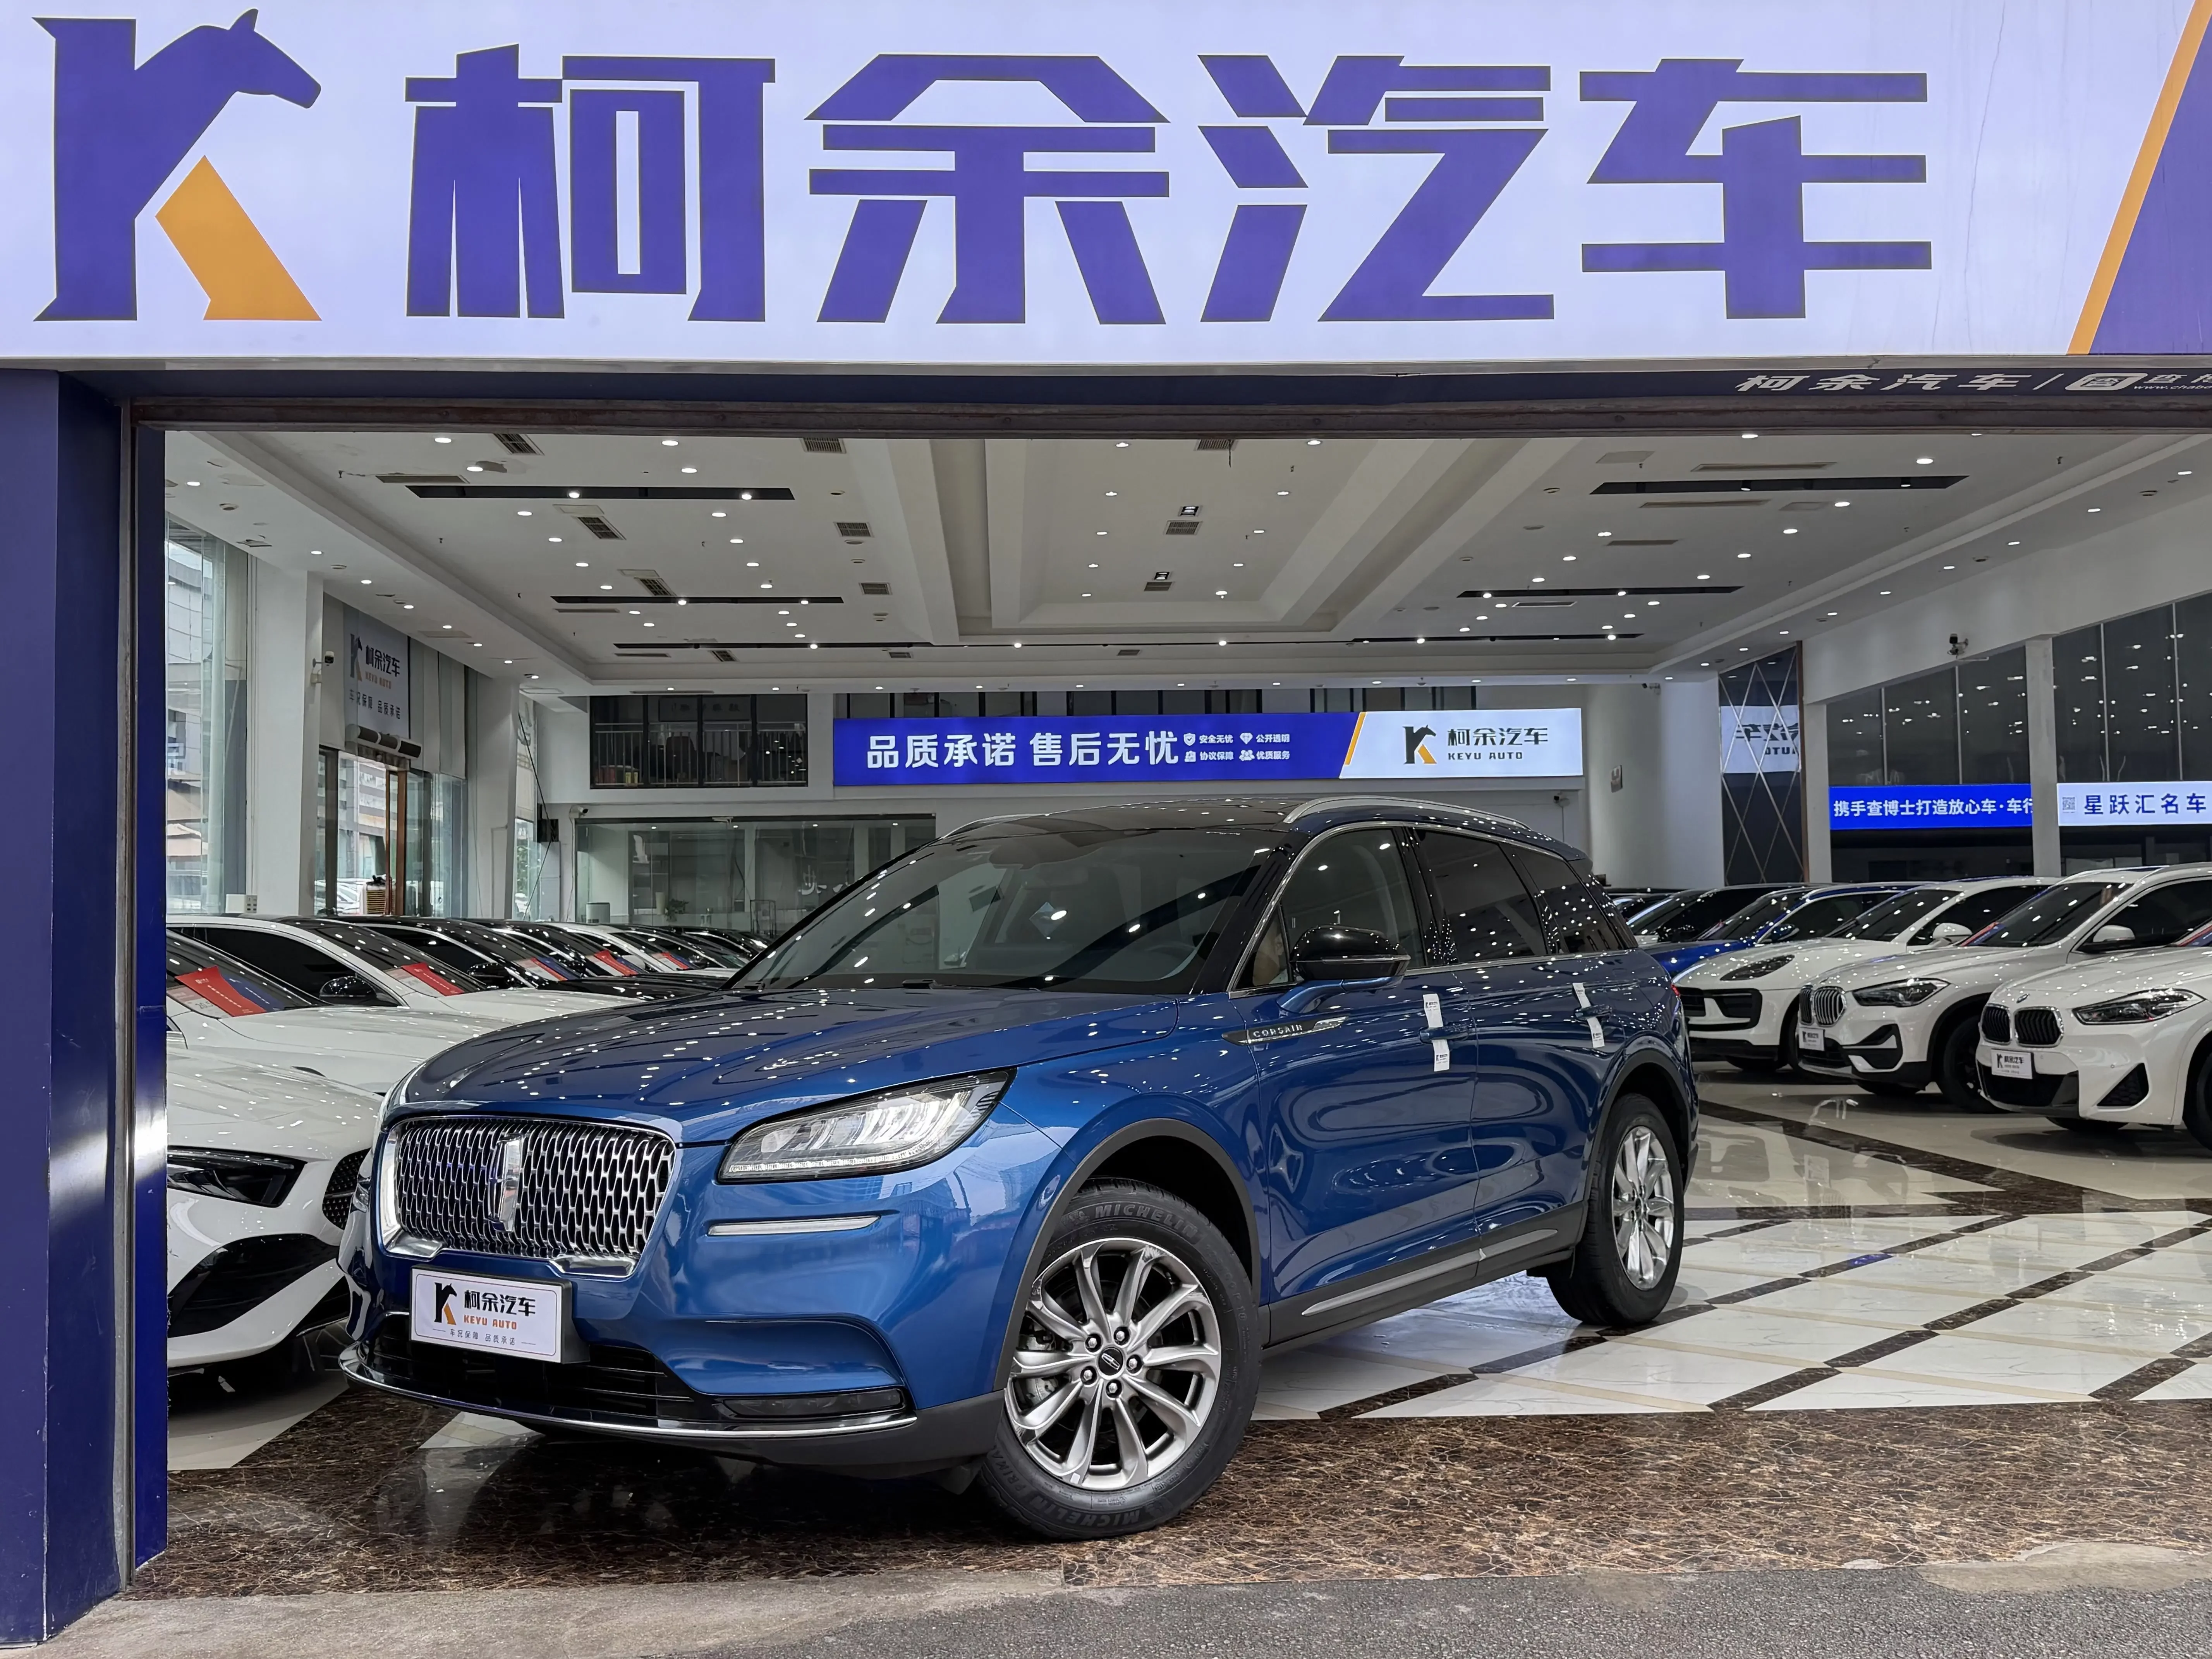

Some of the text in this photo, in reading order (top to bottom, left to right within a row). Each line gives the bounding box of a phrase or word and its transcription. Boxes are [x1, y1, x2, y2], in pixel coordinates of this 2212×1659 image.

[405, 45, 1931, 323] 柯余汽车
[1735, 373, 2032, 392] 柯余汽车
[1199, 734, 1233, 744] 安全无忧
[1256, 734, 1290, 743] 公开透明
[1448, 728, 1548, 746] 柯余汽车
[867, 730, 1178, 768] 品质承诺 售后无忧
[1200, 751, 1234, 760] 协议保障
[1256, 750, 1290, 760] 优质服务
[2084, 792, 2206, 815] 星跃汇名车
[1253, 1024, 1303, 1037] CORSAIR
[1095, 1204, 1198, 1238] MICHELIN
[464, 1289, 536, 1317] 柯余汽车
[464, 1315, 517, 1330] KEYU AUTO
[450, 1329, 516, 1346] 车况保障 品质承诺
[1029, 1495, 1140, 1528] MICHELIN
